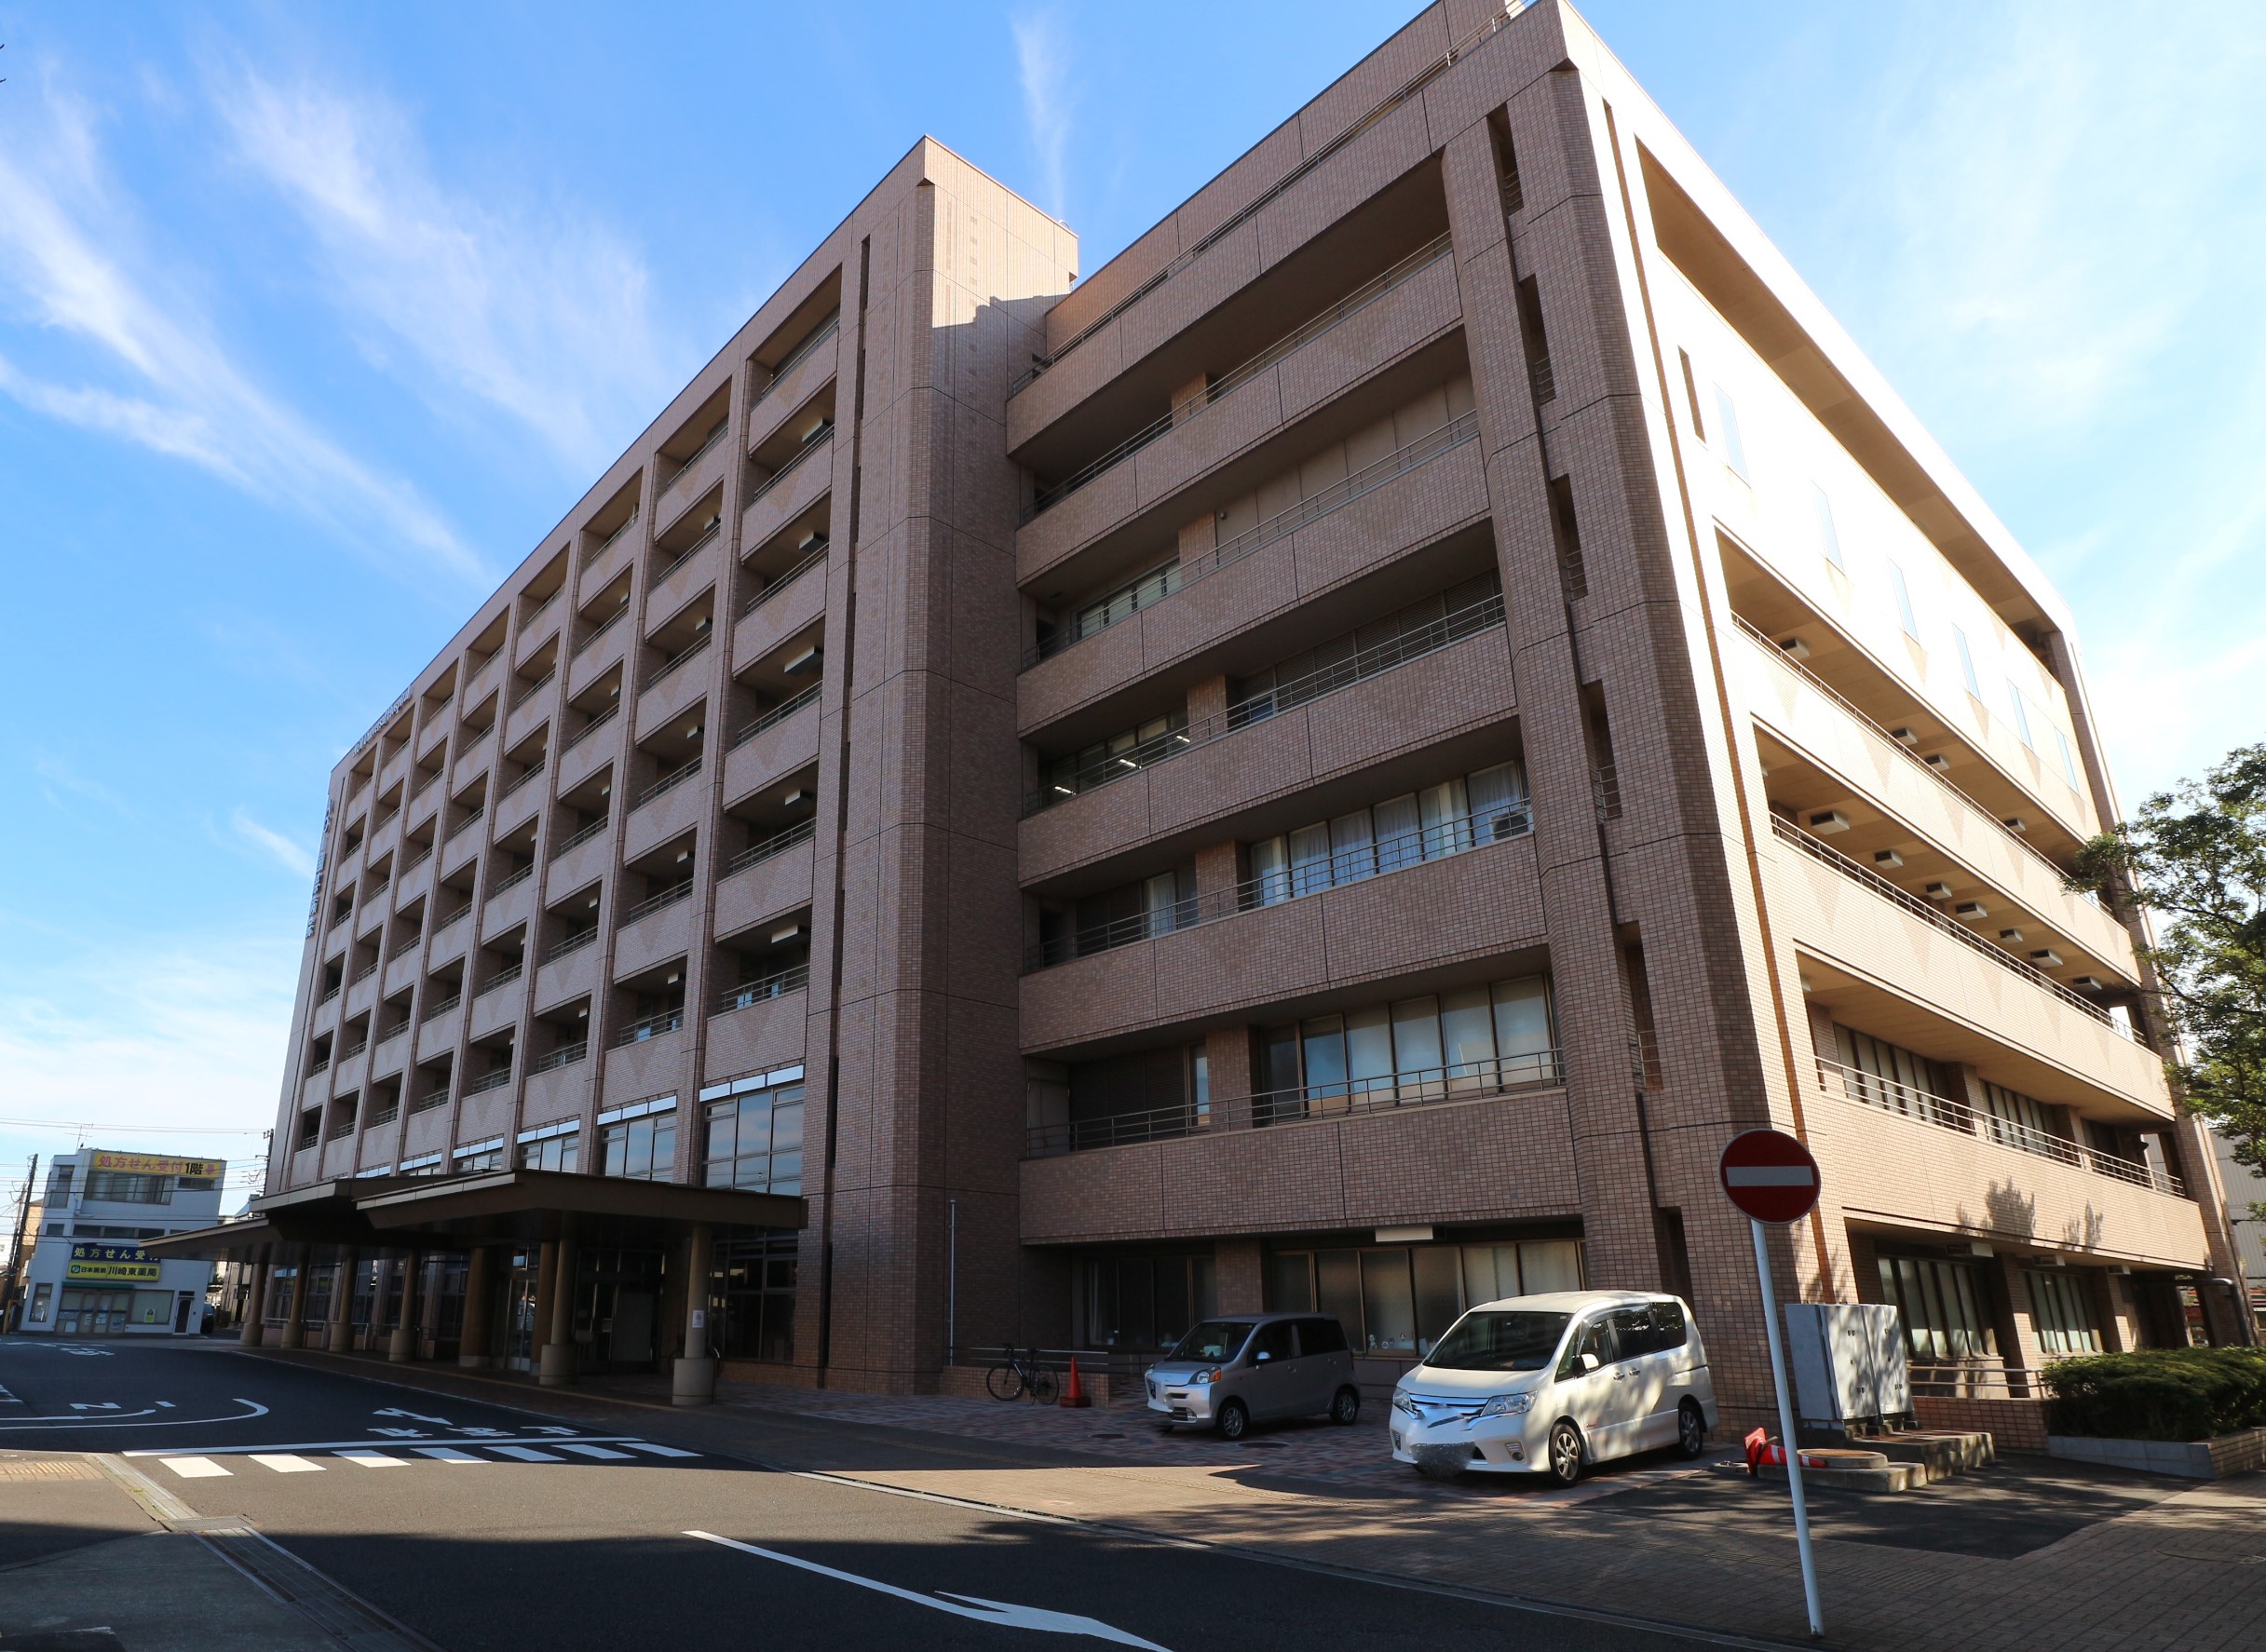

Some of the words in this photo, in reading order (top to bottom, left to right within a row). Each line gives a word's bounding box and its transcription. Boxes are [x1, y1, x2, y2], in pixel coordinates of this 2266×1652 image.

[74, 1246, 159, 1261] 処方せん受
